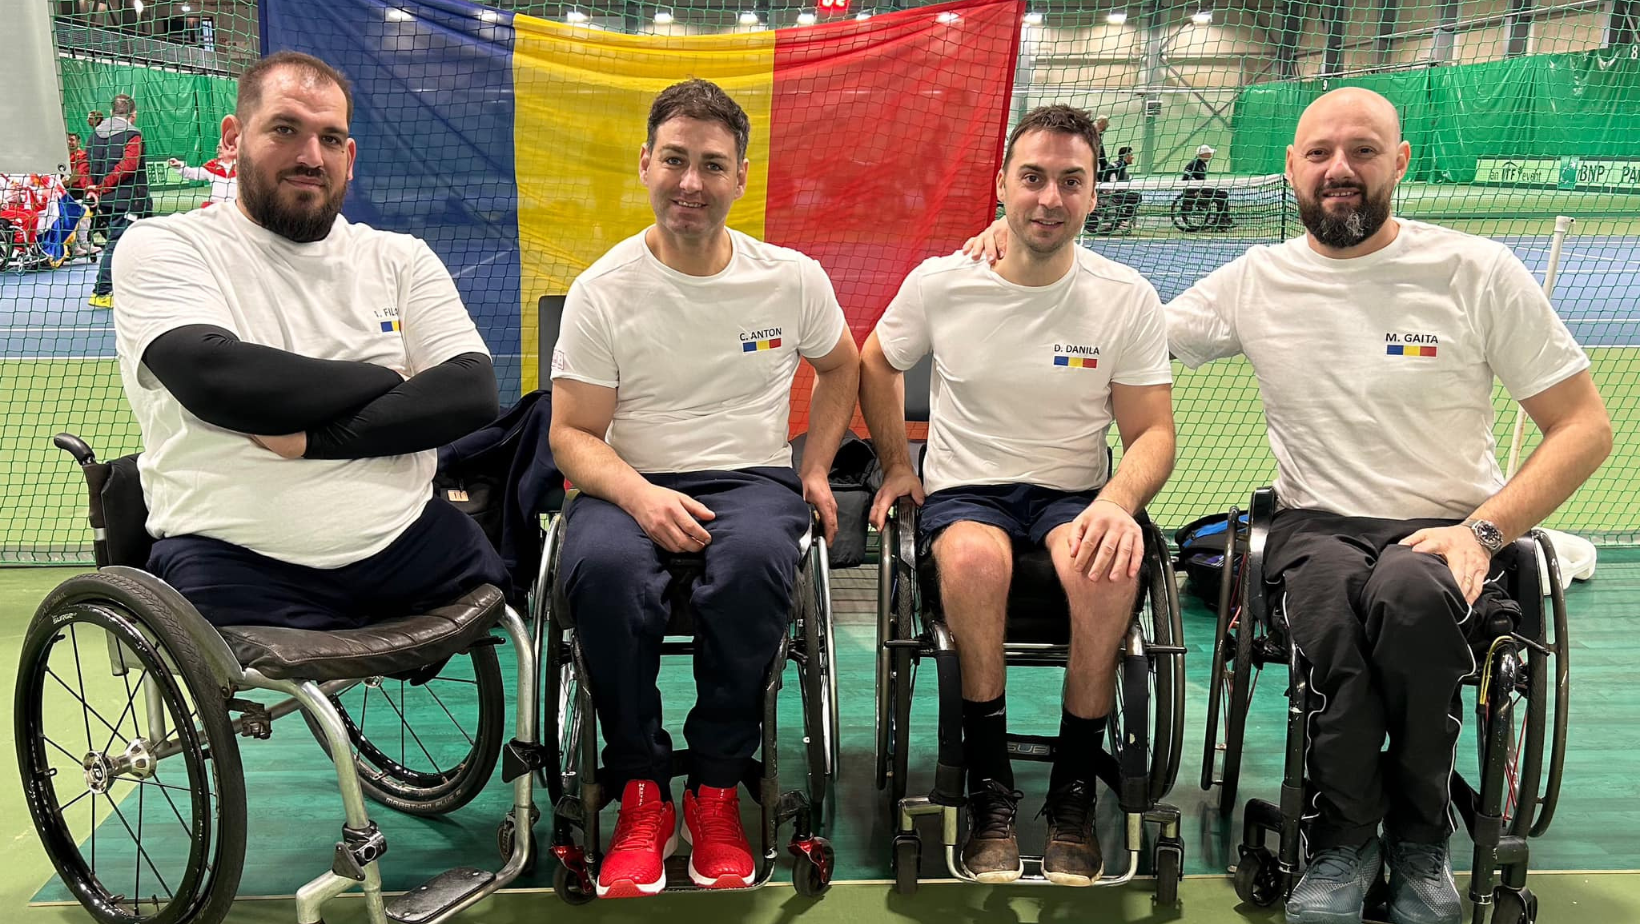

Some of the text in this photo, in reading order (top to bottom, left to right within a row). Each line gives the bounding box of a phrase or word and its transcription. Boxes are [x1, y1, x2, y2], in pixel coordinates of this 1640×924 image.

[1631, 45, 1639, 60] 8
[1579, 164, 1640, 184] BNP PA
[739, 327, 782, 341] C. ANTON
[1385, 332, 1439, 344] M. GAITA
[1054, 344, 1100, 355] D. DANILA
